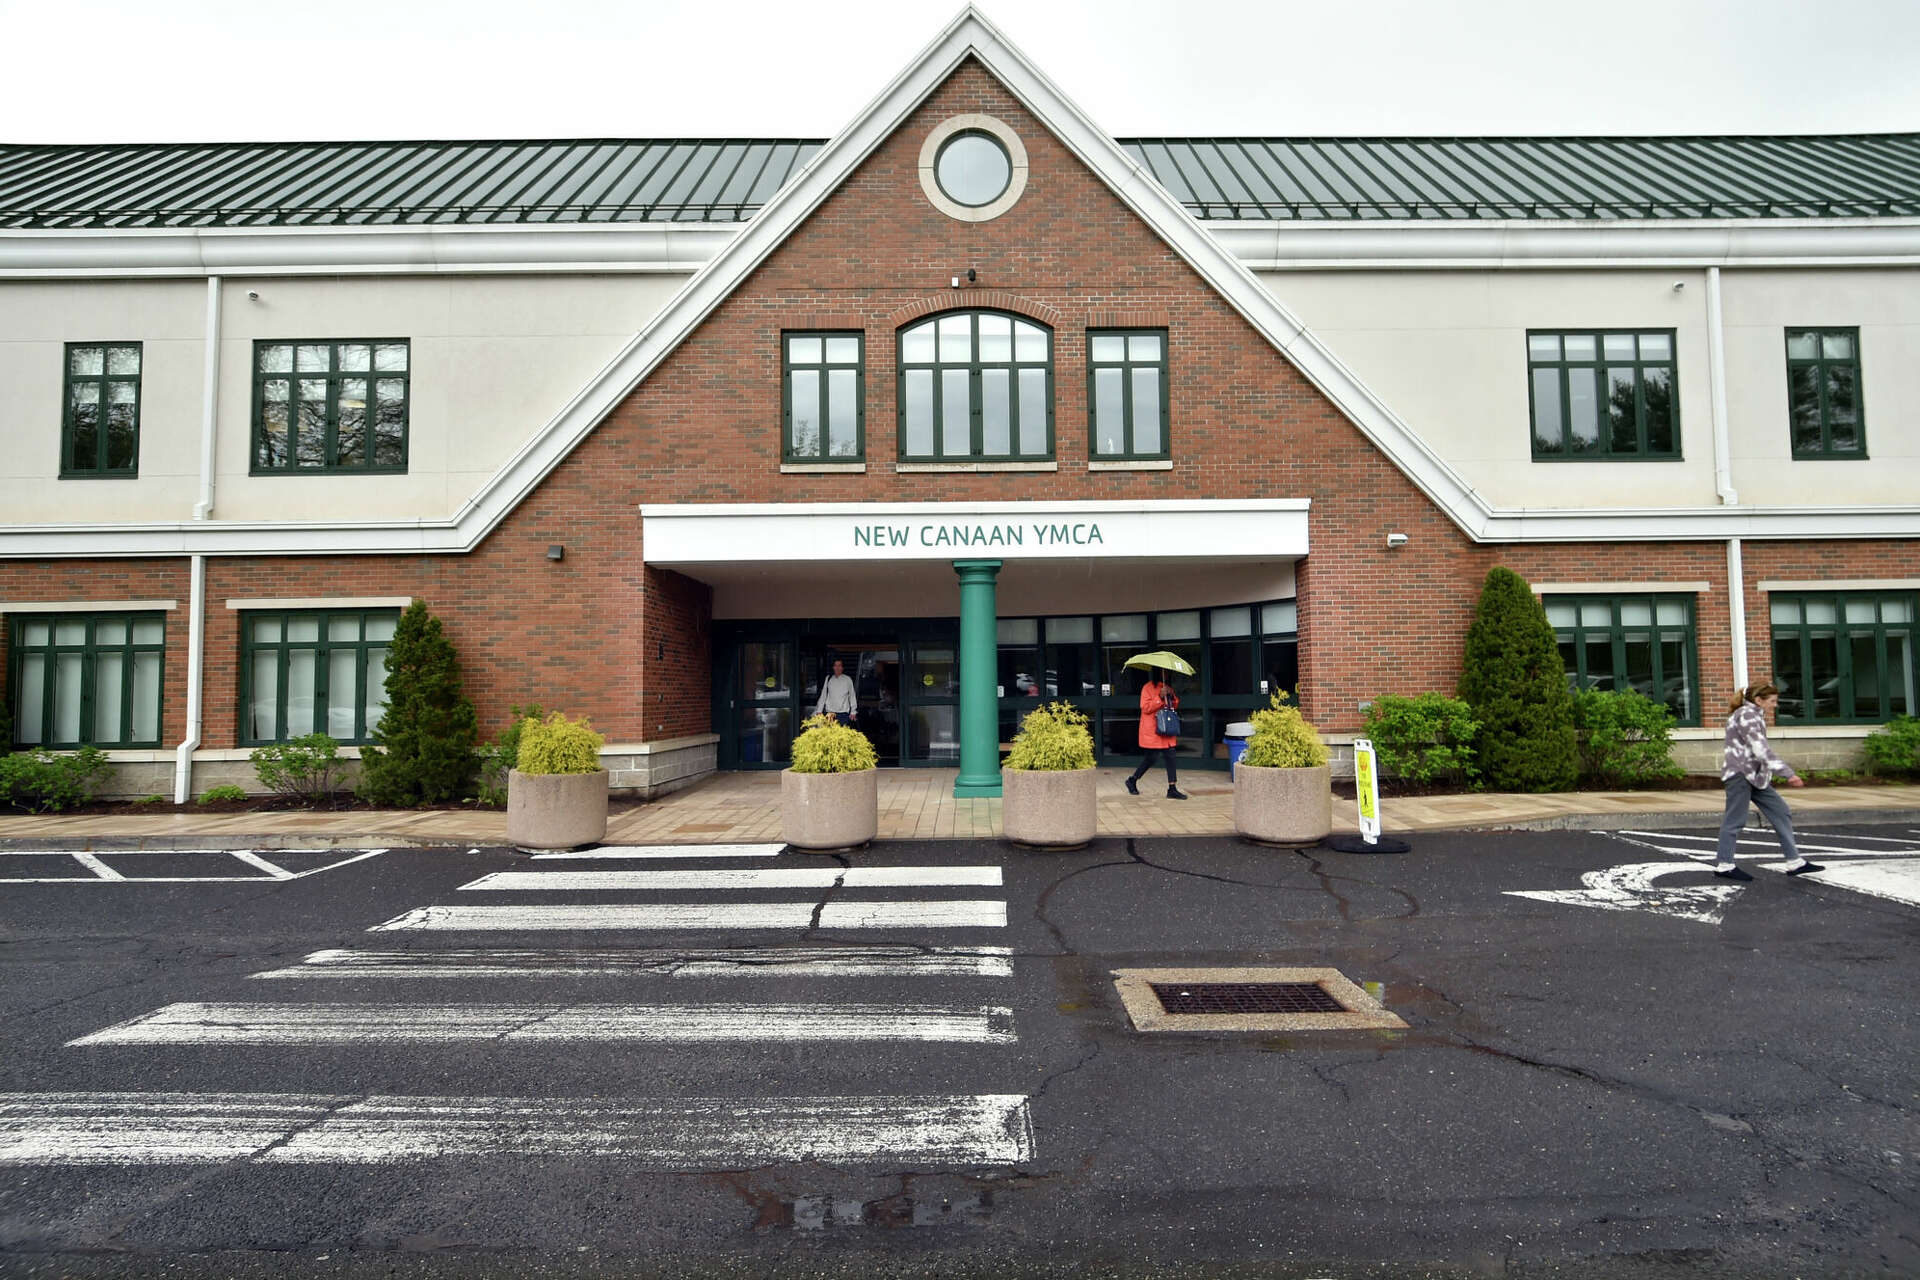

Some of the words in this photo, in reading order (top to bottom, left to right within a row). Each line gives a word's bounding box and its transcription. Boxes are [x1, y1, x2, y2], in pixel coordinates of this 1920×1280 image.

[854, 526, 910, 546] NEW
[920, 525, 1023, 546] CANAAN
[1033, 524, 1104, 545] YMCA
